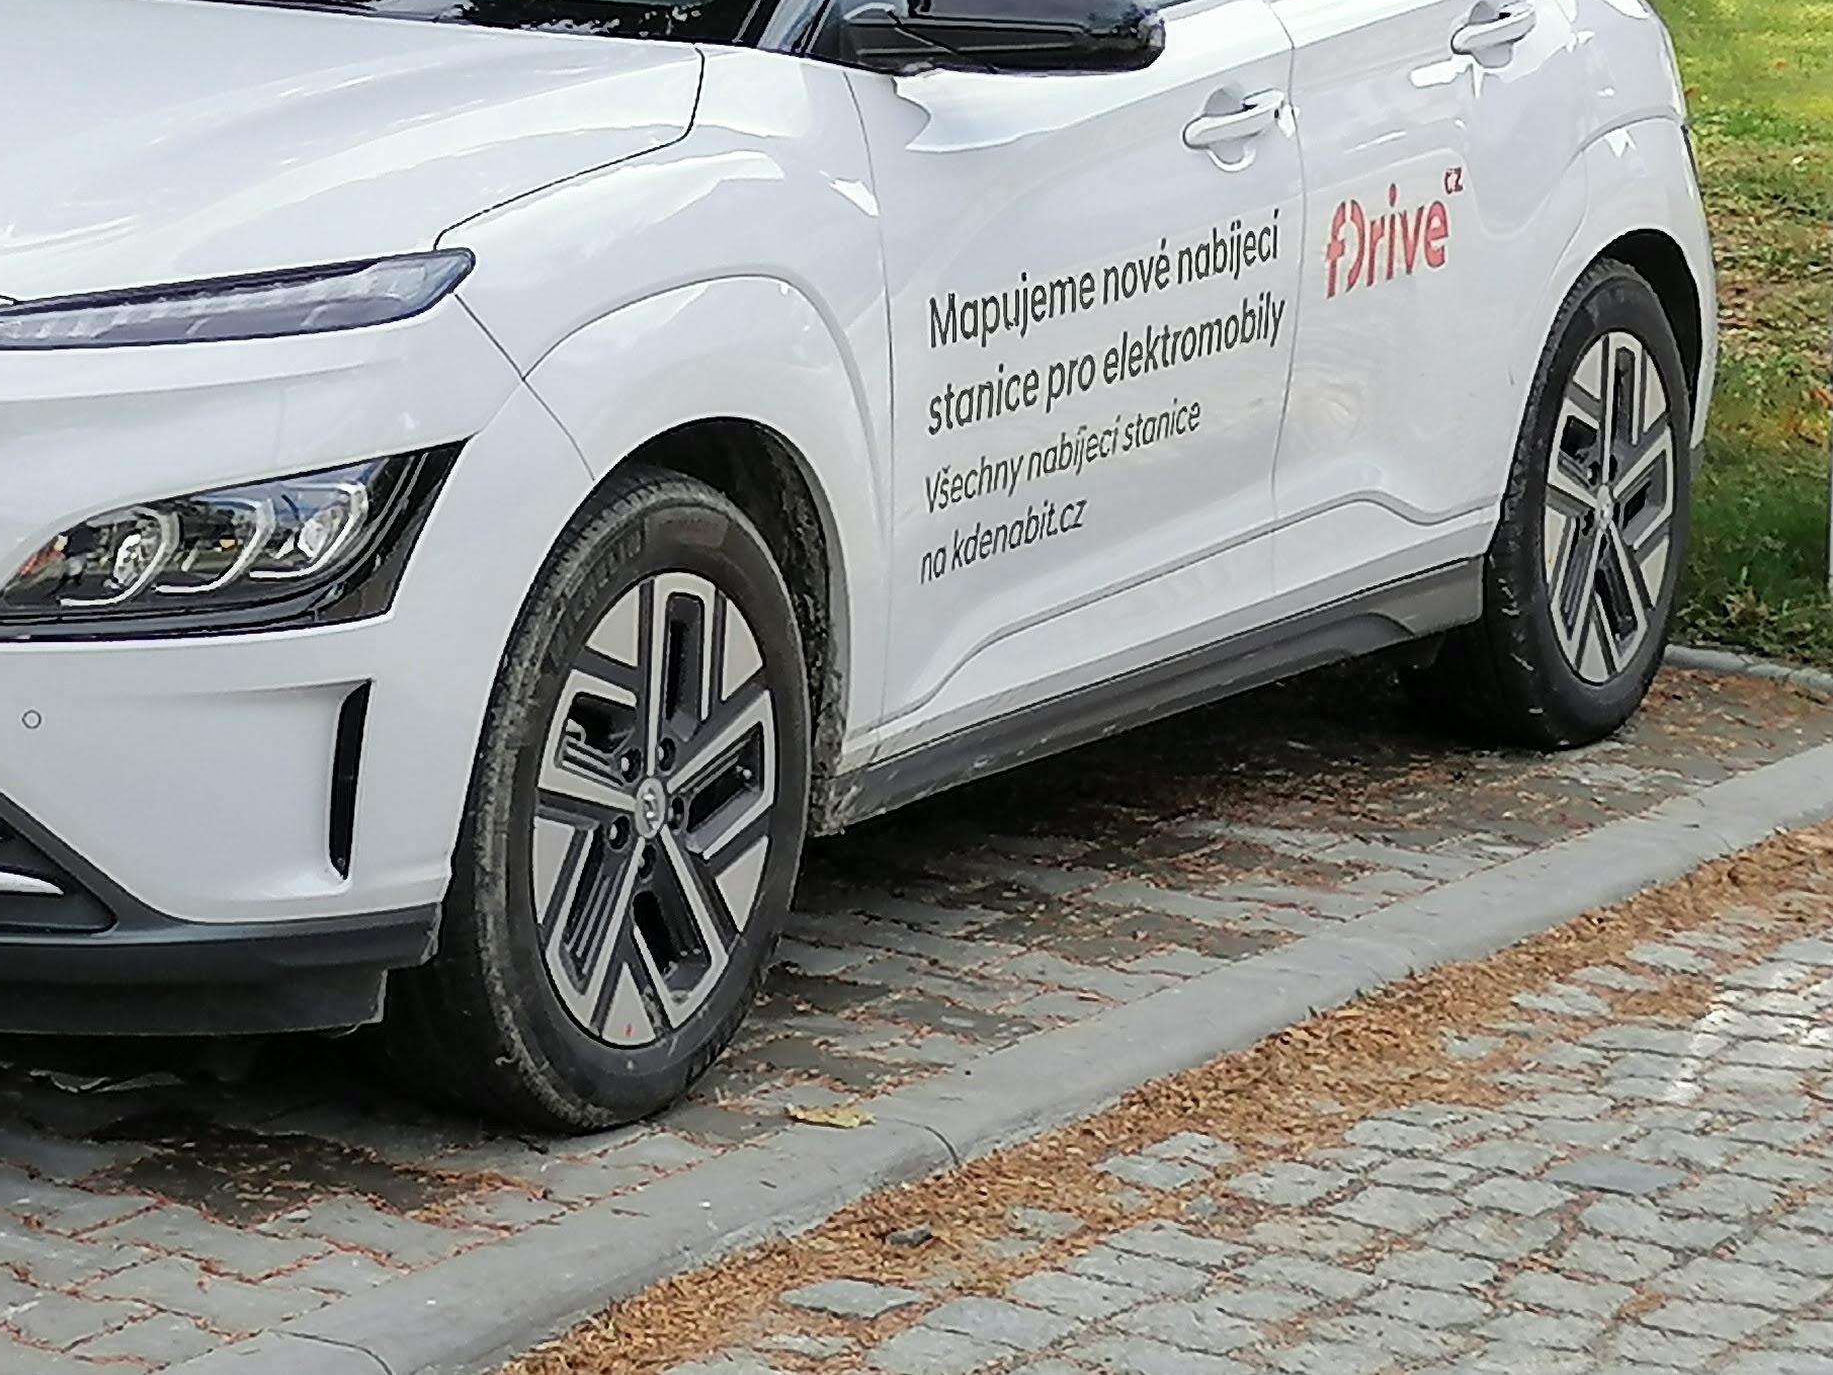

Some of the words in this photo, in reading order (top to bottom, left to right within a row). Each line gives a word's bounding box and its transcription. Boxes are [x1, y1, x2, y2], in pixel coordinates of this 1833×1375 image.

[928, 271, 1096, 347] Mapujeme
[1102, 237, 1170, 305] nové
[1176, 207, 1280, 280] nabíjecí
[928, 362, 1040, 436] stanice
[1045, 353, 1097, 414] pro
[1101, 290, 1286, 385] elektromobily
[925, 454, 1025, 514] Všechny
[1026, 414, 1123, 477] nabíjecí
[1121, 397, 1202, 453] stanice
[920, 545, 947, 585] na
[950, 498, 1088, 571] kdenabit.cz
